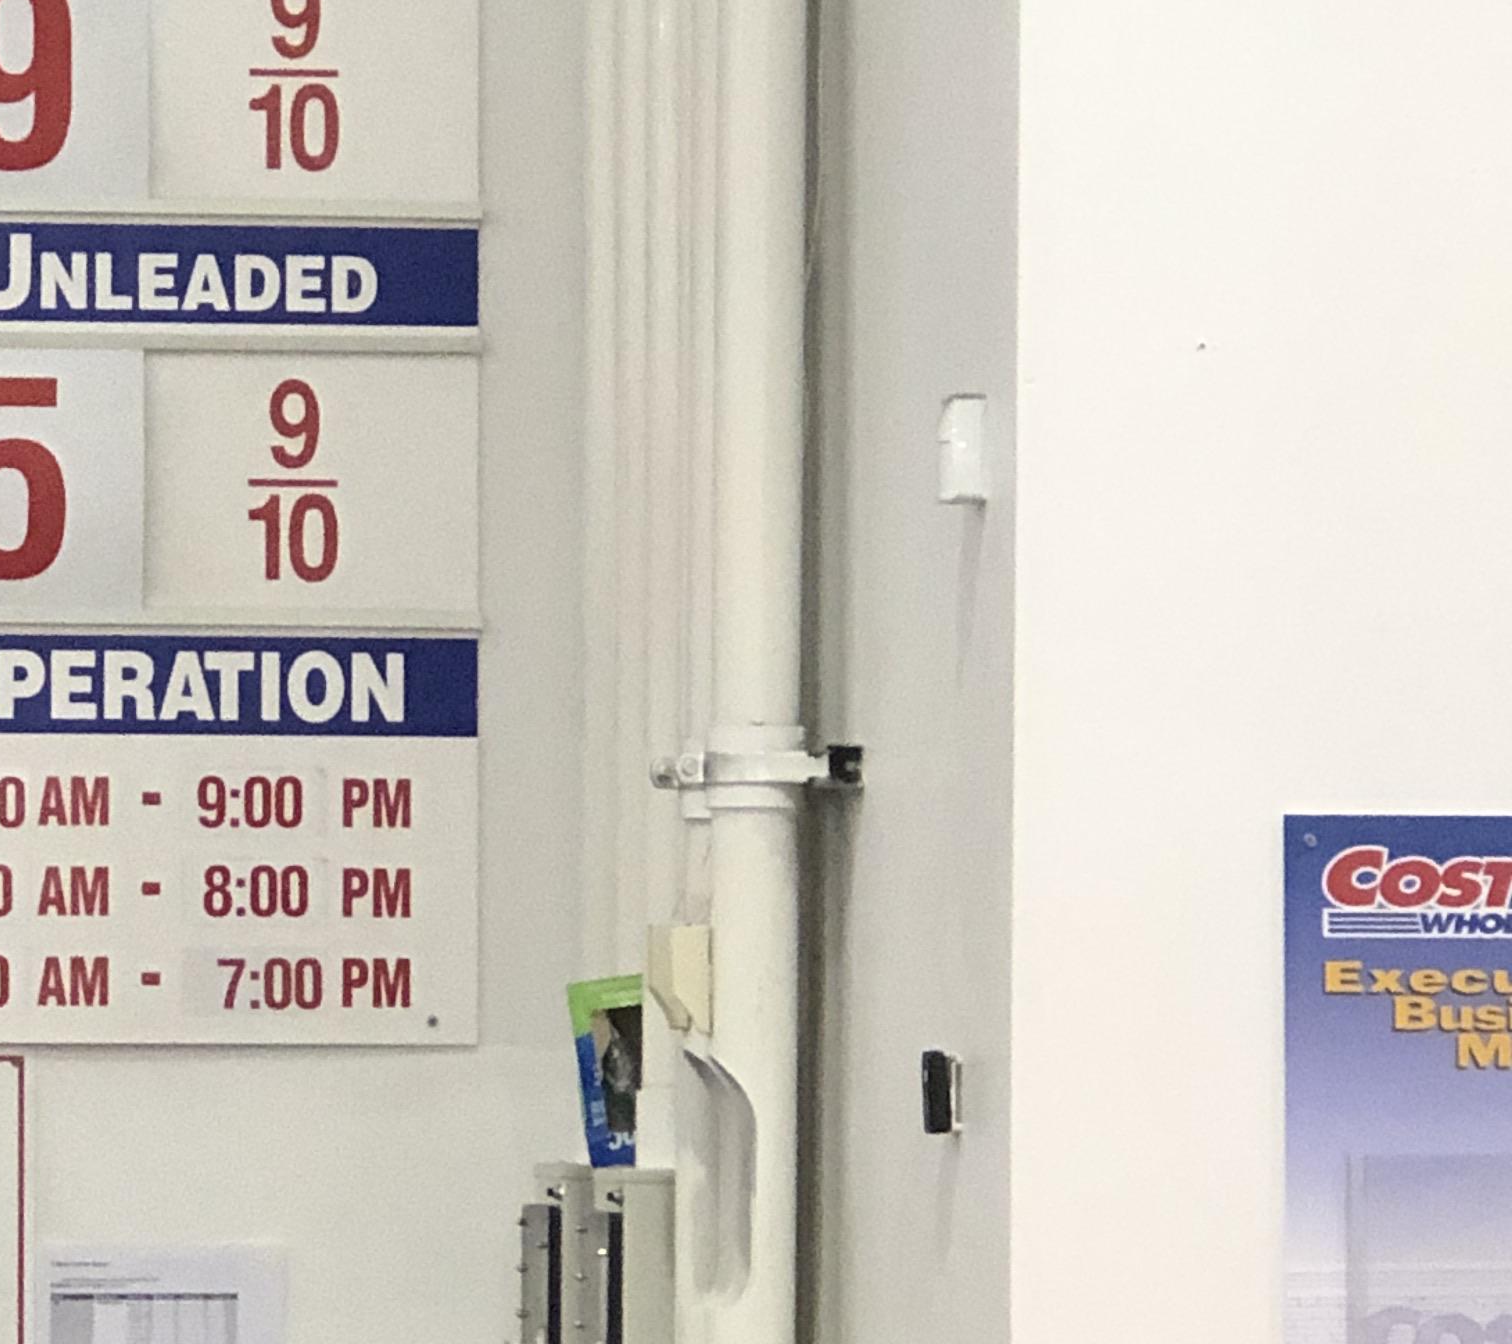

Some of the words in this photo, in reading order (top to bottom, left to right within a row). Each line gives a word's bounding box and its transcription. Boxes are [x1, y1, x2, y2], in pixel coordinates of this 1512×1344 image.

[39, 776, 112, 830] AM
[197, 776, 303, 831] 9:00
[342, 777, 414, 830] PM
[38, 866, 112, 919] AM
[202, 865, 310, 920] 8:00
[342, 866, 414, 920] PM
[38, 955, 112, 1009] AM
[216, 957, 325, 1010] 7:00
[342, 957, 414, 1010] PM
